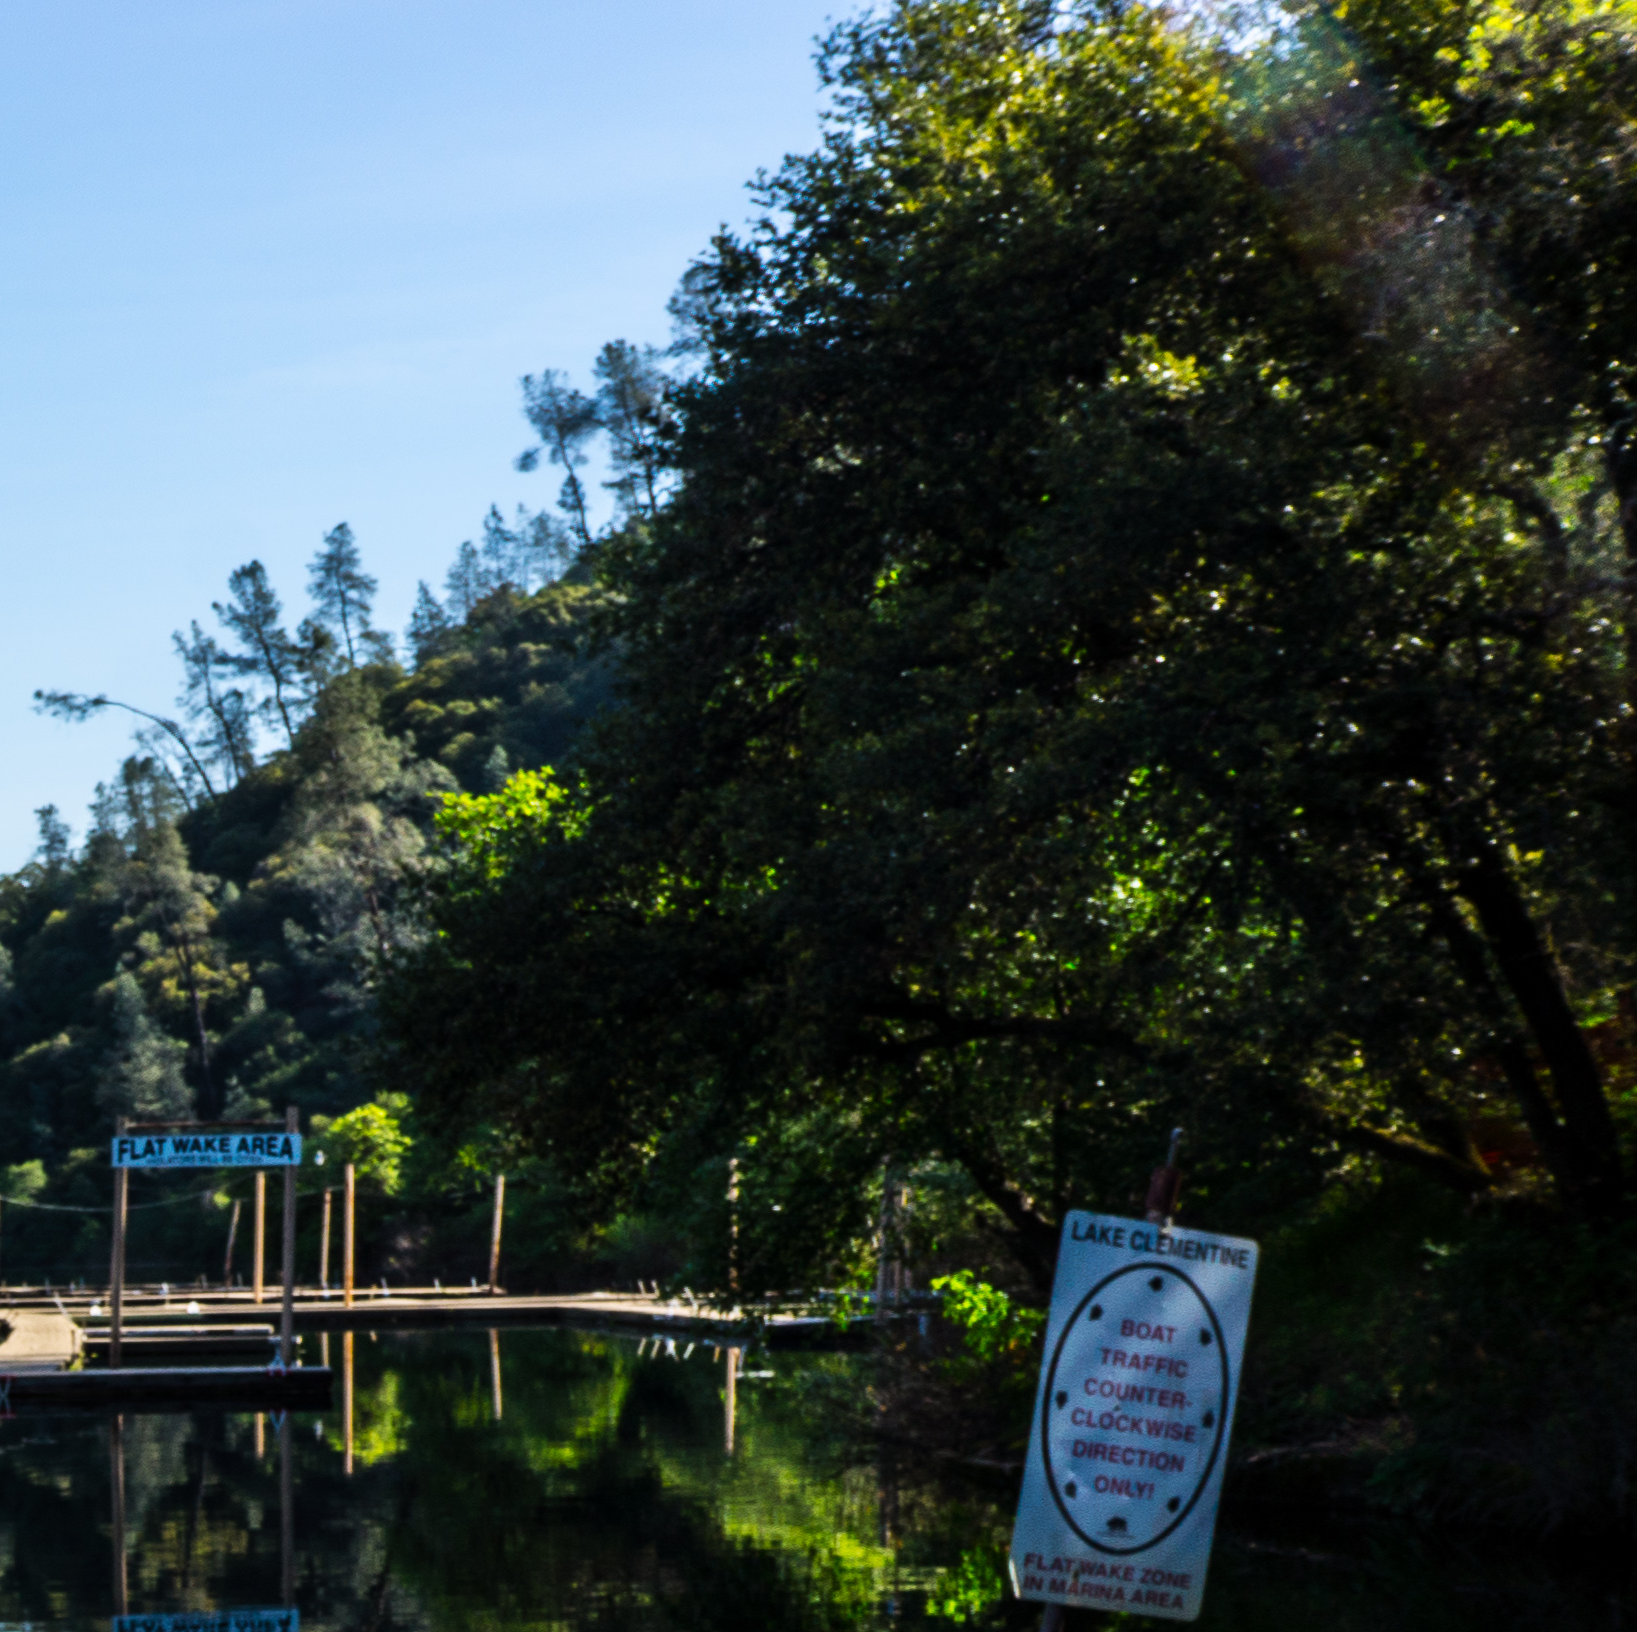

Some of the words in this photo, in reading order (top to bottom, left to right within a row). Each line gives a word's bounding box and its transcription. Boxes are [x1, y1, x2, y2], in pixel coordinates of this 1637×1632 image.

[117, 1138, 167, 1164] FLAT
[172, 1136, 230, 1154] WAKE
[236, 1135, 294, 1162] AREA
[1071, 1221, 1125, 1248] LAKE
[1129, 1229, 1250, 1270] CLEMENTINE
[1120, 1318, 1177, 1344] BOAT
[1099, 1347, 1189, 1379] TRAFFIC
[1083, 1377, 1193, 1410] COUNTER-
[1071, 1406, 1197, 1444] CLOCKWISE
[1072, 1438, 1185, 1473] DIRECTION
[1093, 1473, 1156, 1500] ONLY!
[1023, 1551, 1076, 1573] FLAT
[1079, 1557, 1136, 1582] WAKE
[1139, 1566, 1193, 1591] ZONE
[1022, 1573, 1044, 1592] IN
[1048, 1577, 1125, 1601] MARINA
[1130, 1587, 1185, 1610] AREA
